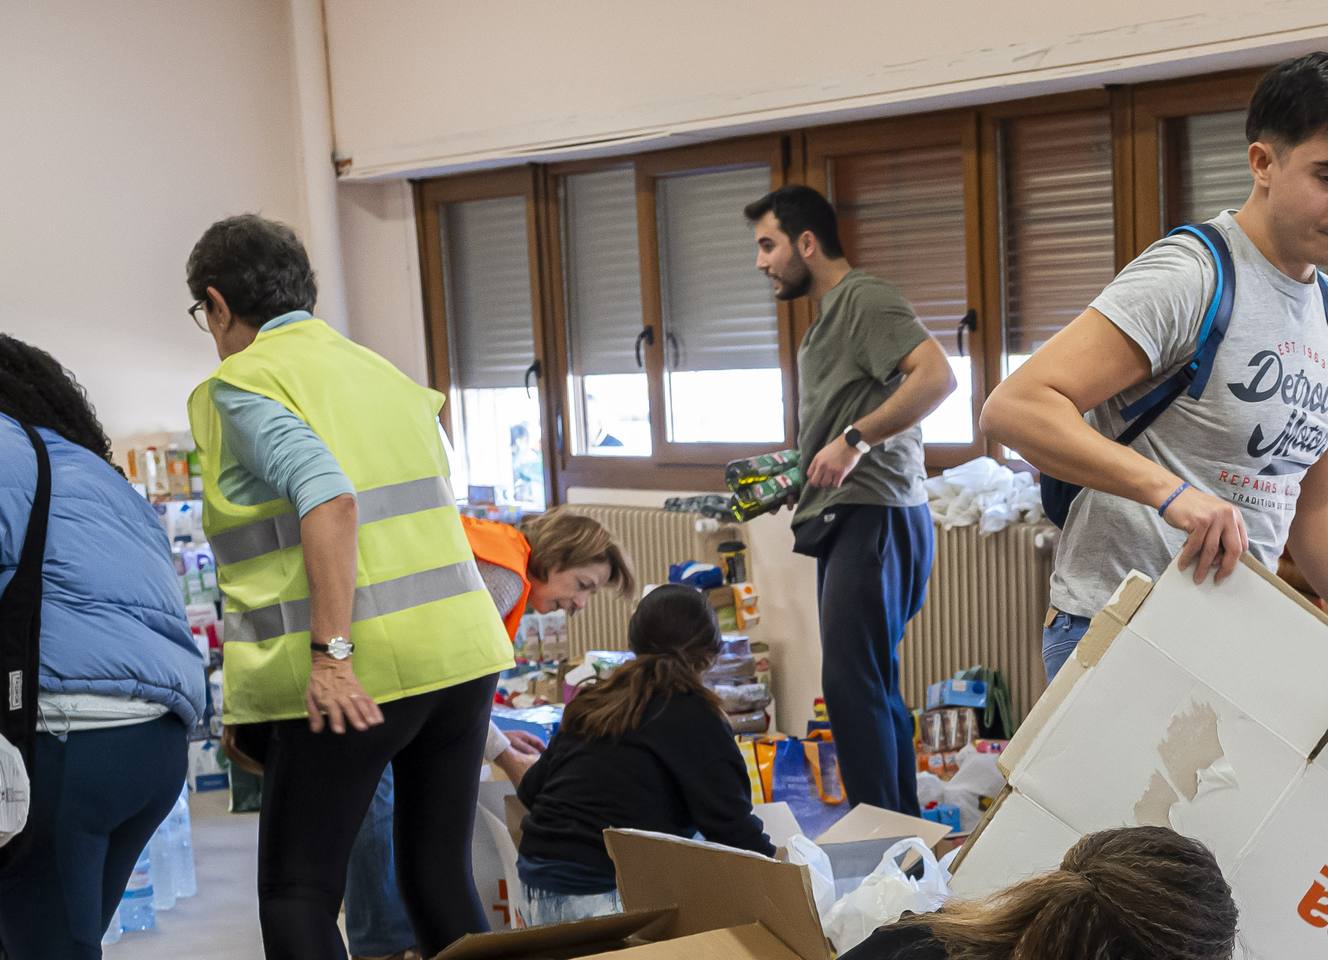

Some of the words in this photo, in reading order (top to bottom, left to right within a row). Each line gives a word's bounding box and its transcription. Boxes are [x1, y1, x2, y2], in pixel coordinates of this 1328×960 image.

[1277, 341, 1296, 356] EST
[1303, 344, 1327, 369] 1963
[1218, 470, 1278, 494] REPAIRS
[1231, 492, 1276, 509] TRADITION
